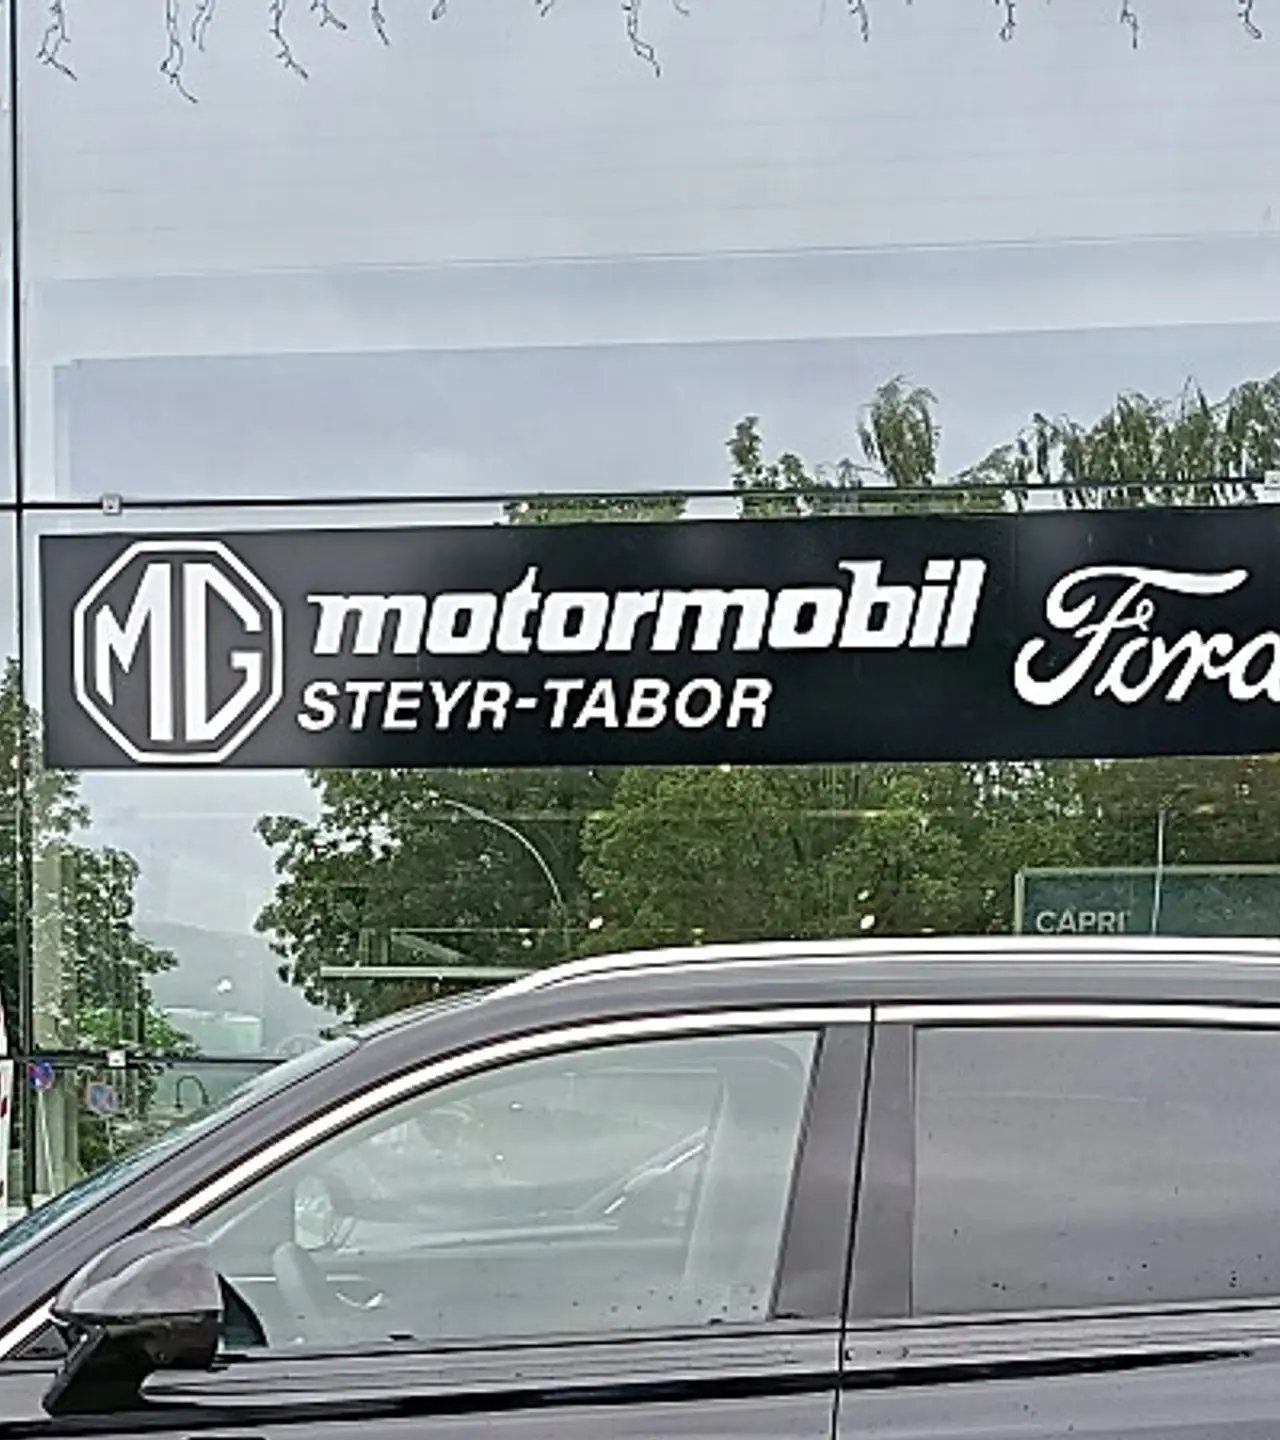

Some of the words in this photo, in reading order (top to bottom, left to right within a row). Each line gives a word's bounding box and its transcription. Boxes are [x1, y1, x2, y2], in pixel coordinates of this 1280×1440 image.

[306, 558, 987, 656] motormobil
[94, 563, 263, 743] MG
[296, 678, 773, 733] STEYR-TABOR
[1035, 910, 1127, 933] CAPRI
